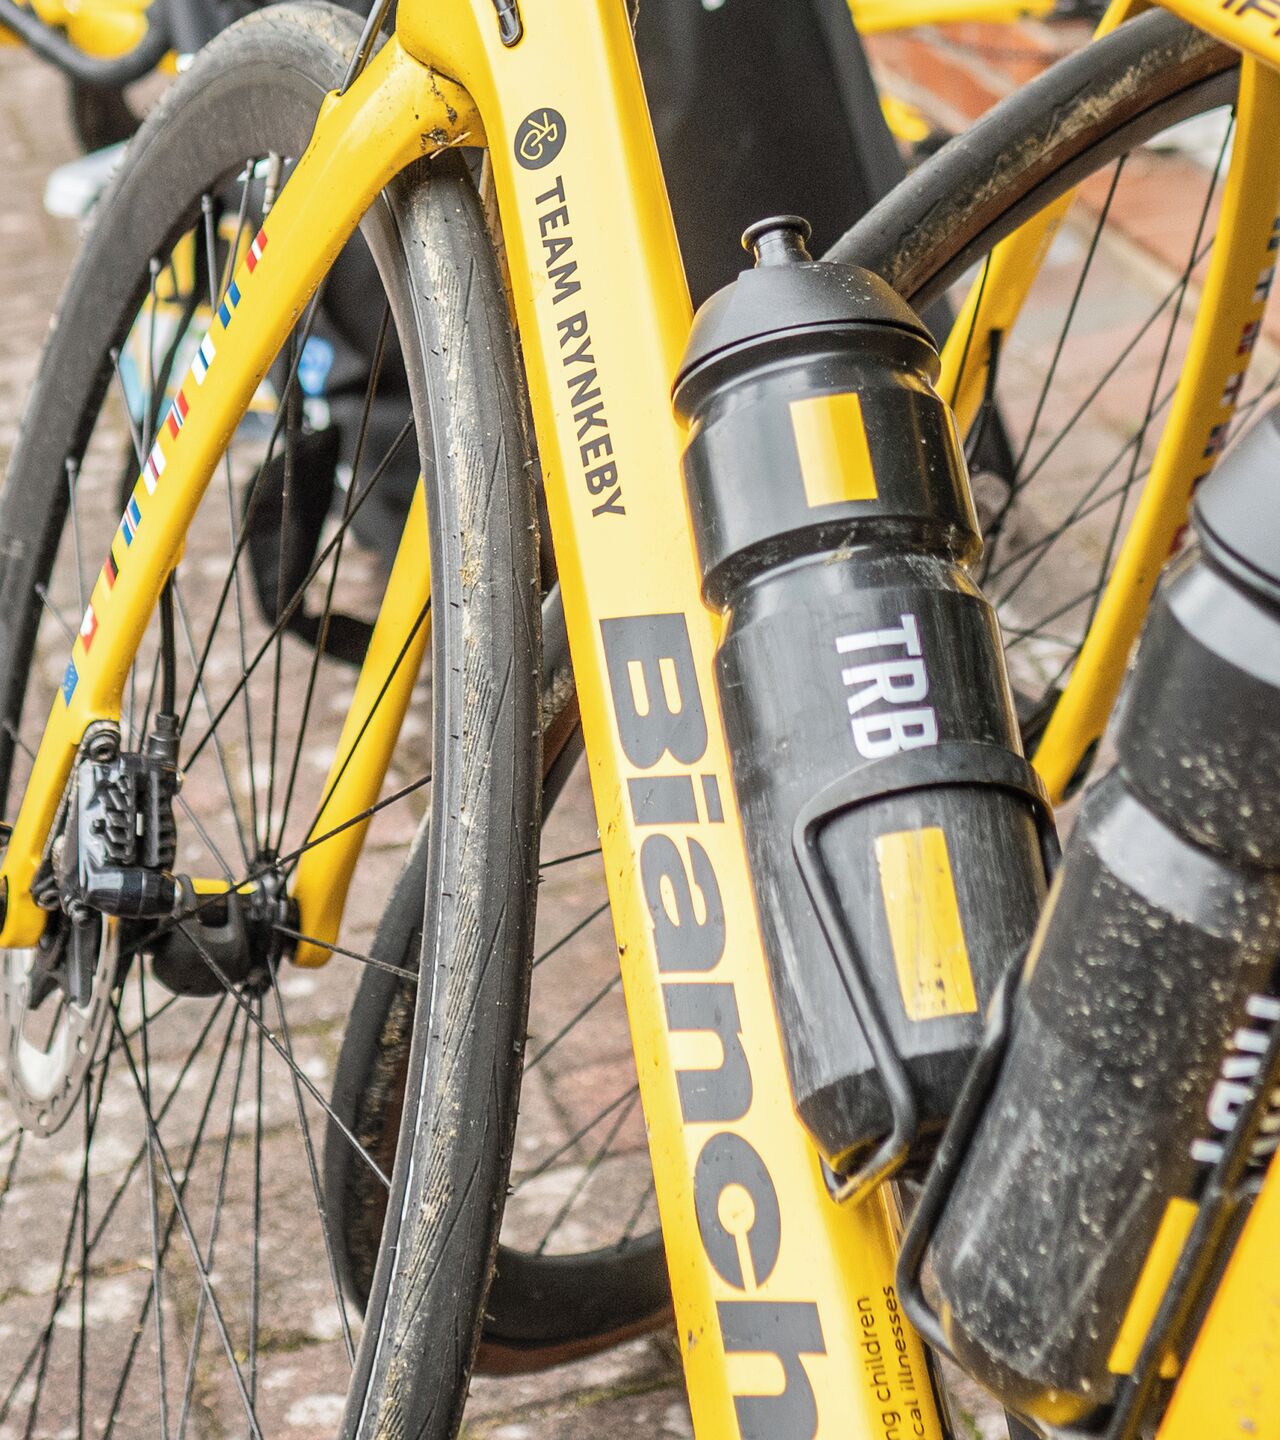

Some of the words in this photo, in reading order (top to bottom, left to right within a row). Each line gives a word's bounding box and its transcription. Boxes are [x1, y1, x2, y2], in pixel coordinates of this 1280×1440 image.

[535, 175, 582, 305] TEAM
[556, 310, 627, 518] RYNKEBY
[856, 1293, 892, 1403] children
[882, 1285, 917, 1392] illnesses
